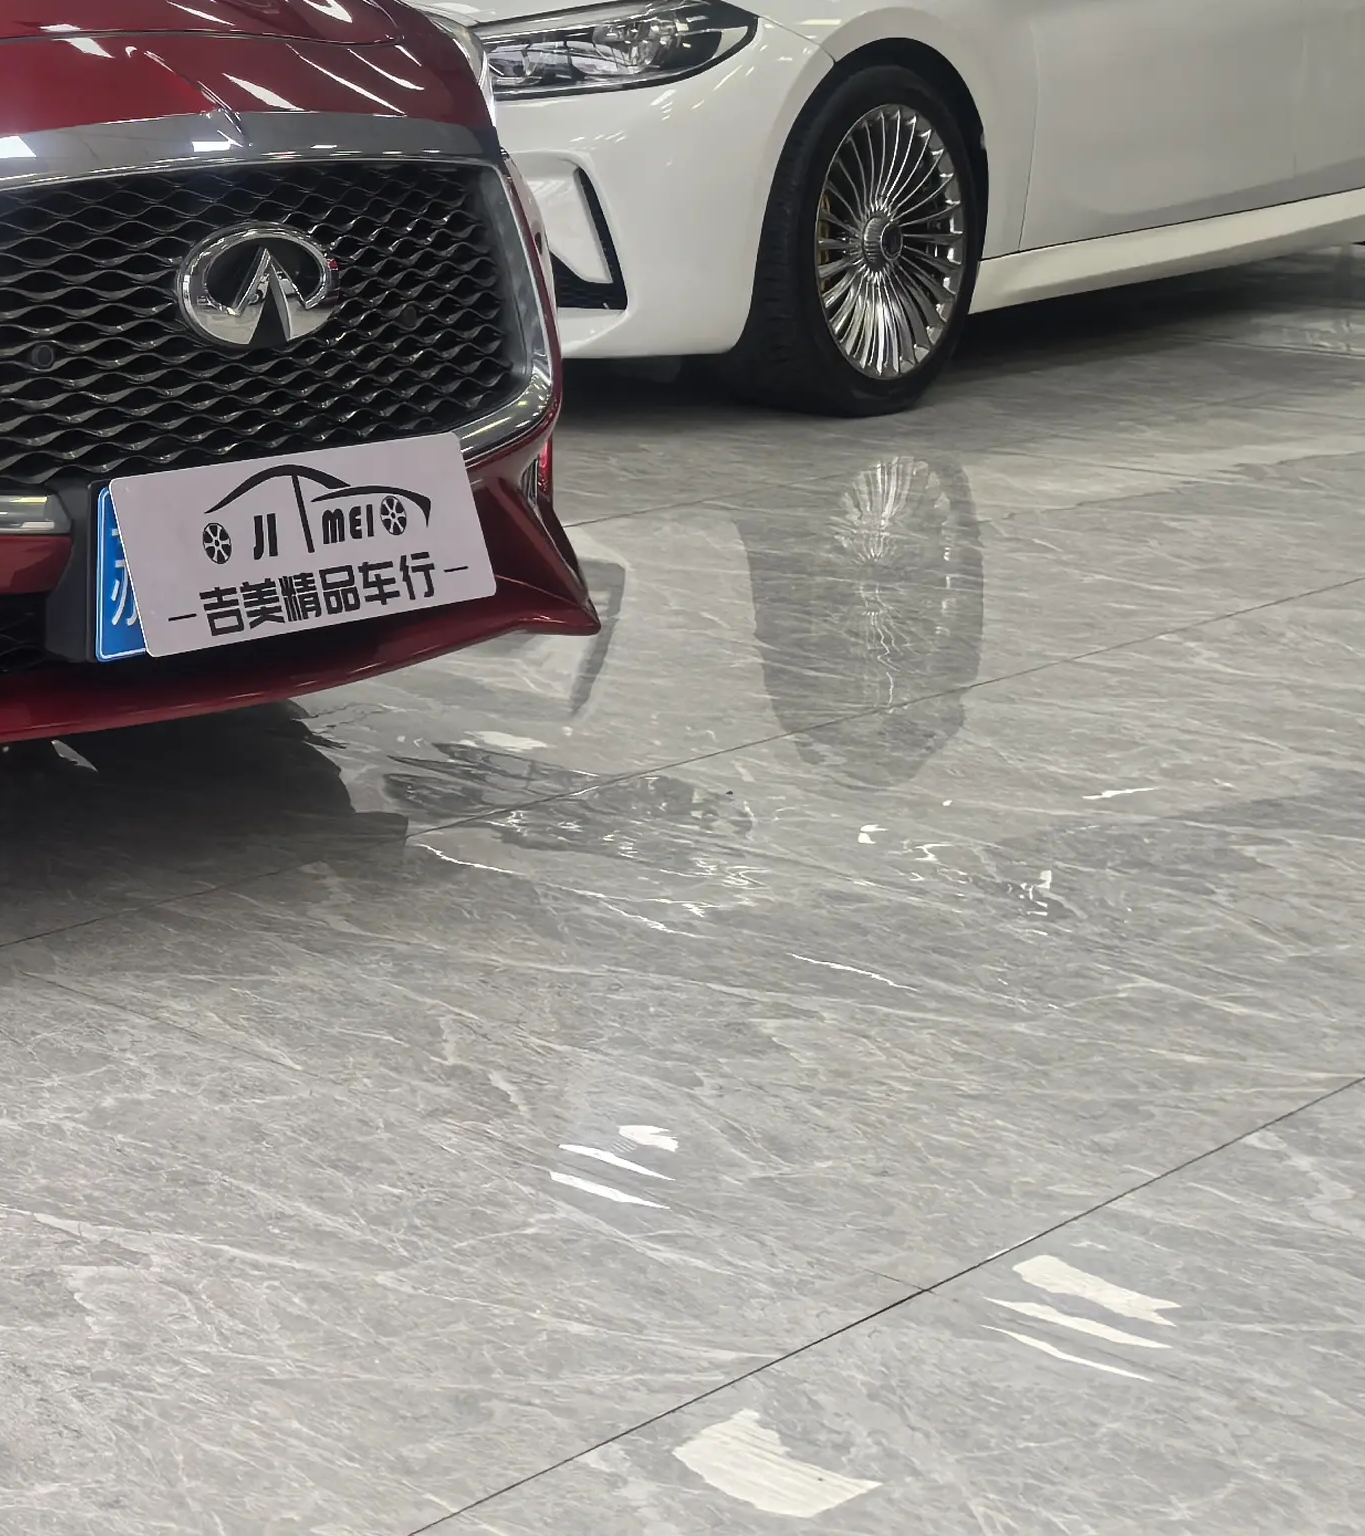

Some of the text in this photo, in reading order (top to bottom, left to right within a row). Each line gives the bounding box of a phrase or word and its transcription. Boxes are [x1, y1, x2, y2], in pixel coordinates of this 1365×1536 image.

[253, 513, 279, 560] JI
[199, 551, 436, 636] 吉美精品车行
